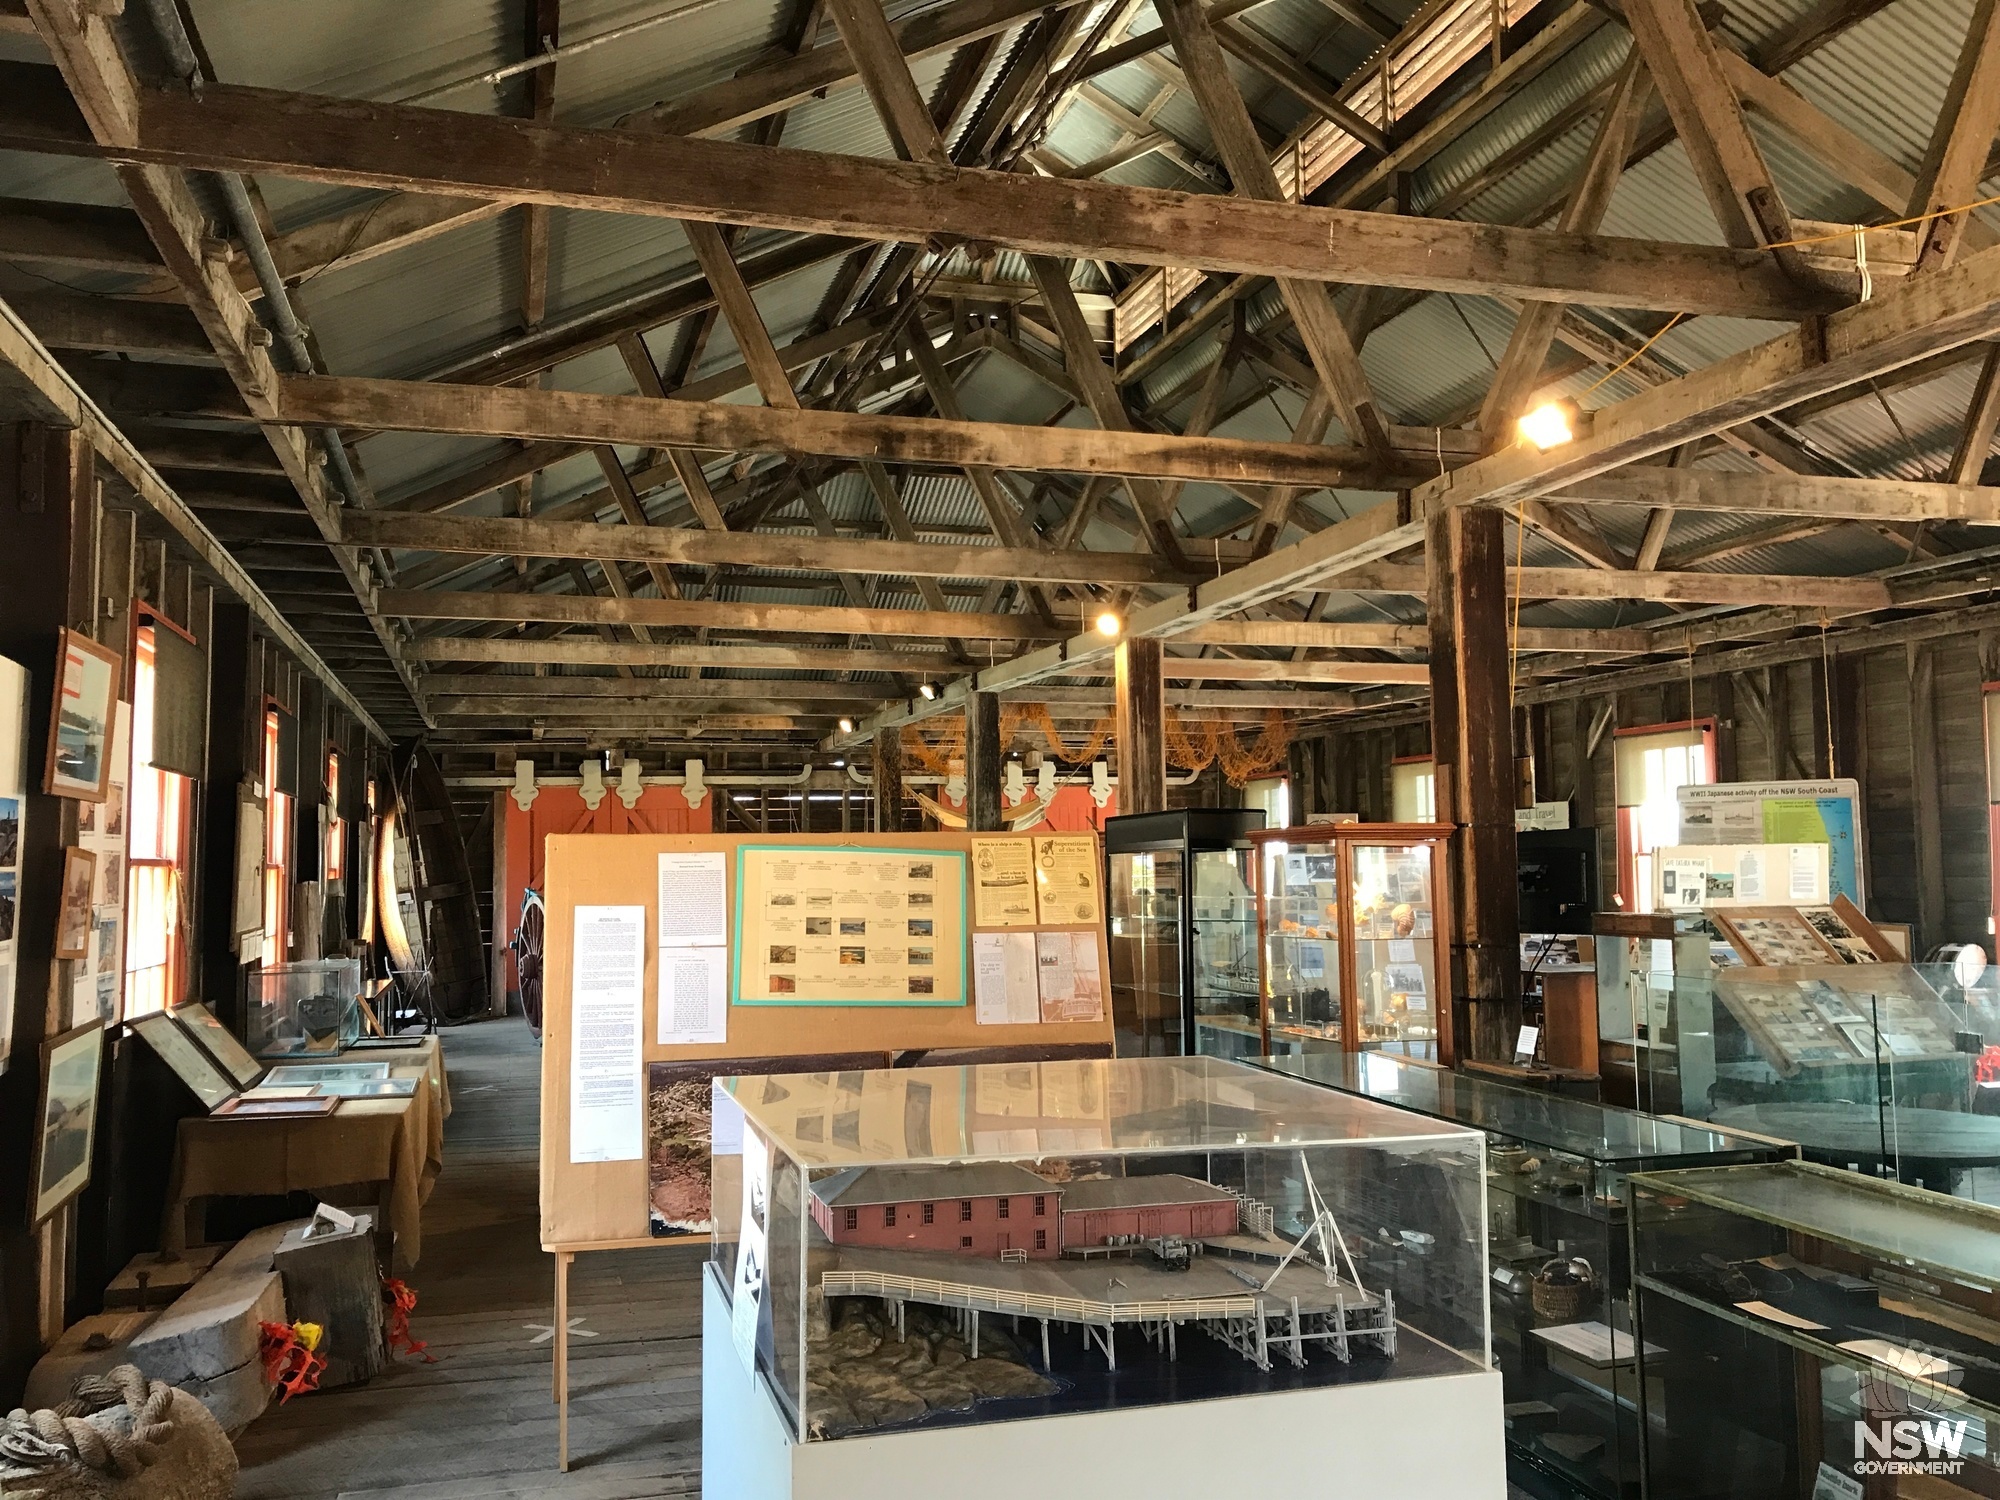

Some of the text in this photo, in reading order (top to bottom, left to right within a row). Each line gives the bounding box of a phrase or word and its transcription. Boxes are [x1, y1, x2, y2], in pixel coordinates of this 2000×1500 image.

[1707, 790, 1734, 798] Japanese
[1735, 789, 1757, 797] activity
[1759, 788, 1767, 796] off
[1781, 787, 1796, 795] NSW
[1798, 786, 1817, 795] South
[1819, 786, 1838, 794] Coast
[1519, 805, 1556, 820] and Travel
